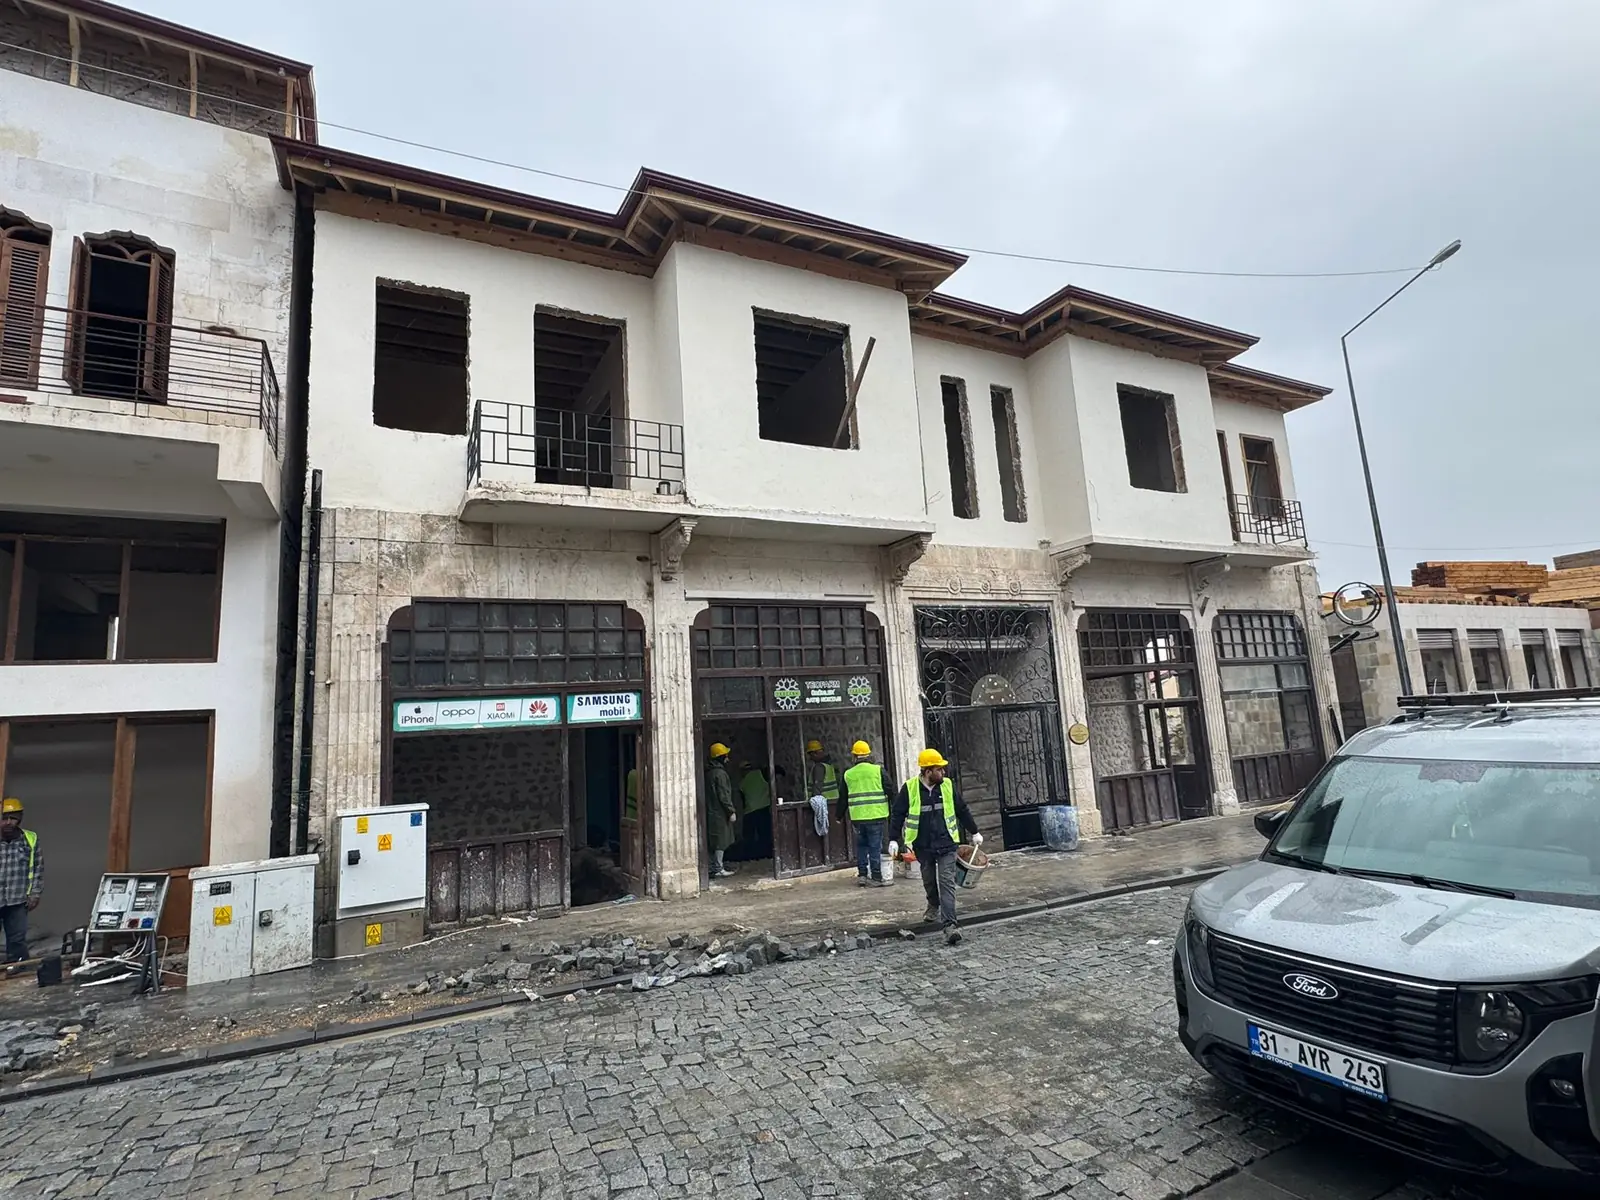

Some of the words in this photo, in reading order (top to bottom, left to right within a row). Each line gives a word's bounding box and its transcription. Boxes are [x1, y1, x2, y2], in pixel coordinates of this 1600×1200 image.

[577, 694, 631, 707] SAMSUNG
[401, 714, 434, 725] iPhone
[441, 708, 476, 718] oppo
[1293, 976, 1326, 997] Ford
[1258, 1030, 1279, 1055] 31
[1298, 1042, 1332, 1074] AYR
[1342, 1058, 1381, 1088] 243
